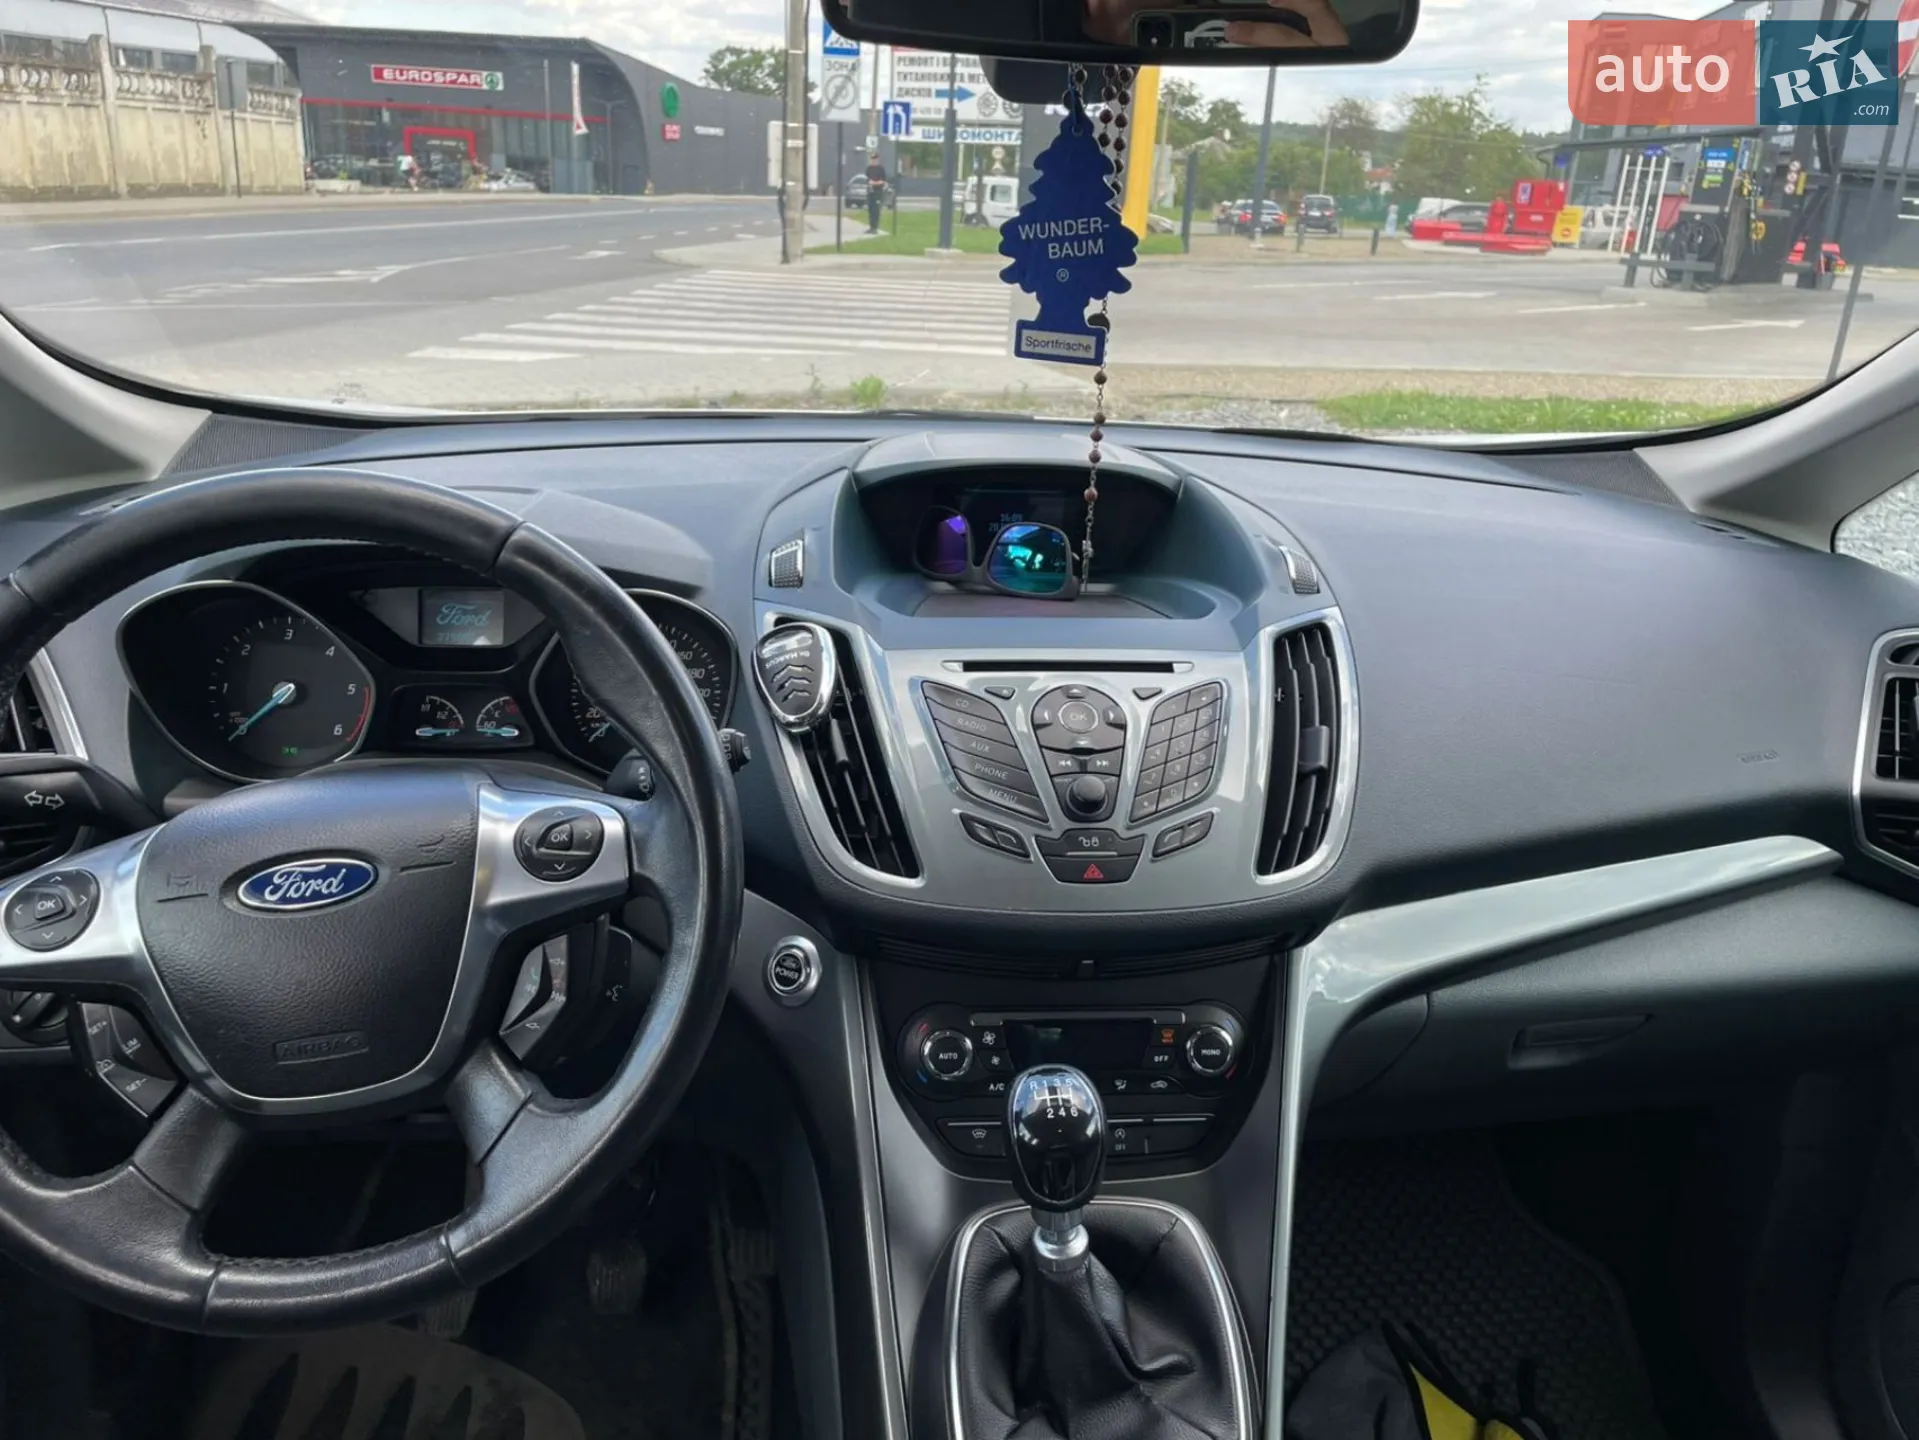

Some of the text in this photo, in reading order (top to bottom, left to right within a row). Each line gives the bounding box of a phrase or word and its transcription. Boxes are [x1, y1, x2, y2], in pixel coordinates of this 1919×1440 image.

[825, 59, 857, 72] ЗОНА
[382, 67, 482, 86] EUROSPAR
[1018, 217, 1110, 240] WUNDER-
[1048, 238, 1104, 260] BAUM
[1024, 336, 1092, 354] Sportfrische
[436, 602, 492, 627] Ford
[955, 699, 970, 708] CD
[1069, 711, 1088, 723] OK
[957, 717, 987, 732] RADIO
[971, 740, 991, 753] AUX
[974, 762, 1009, 780] PHONE
[988, 788, 1018, 803] MENU
[551, 833, 569, 843] OK
[263, 864, 346, 902] Ford
[37, 899, 57, 912] OK
[938, 1052, 958, 1061] AUTO
[1201, 1048, 1221, 1056] MONO
[1153, 1055, 1169, 1063] OFF
[989, 1082, 1006, 1092] A/C
[1029, 1080, 1037, 1091] R
[1053, 1079, 1061, 1088] 3
[1066, 1078, 1073, 1087] 5
[1046, 1106, 1079, 1119] 2 4 6
